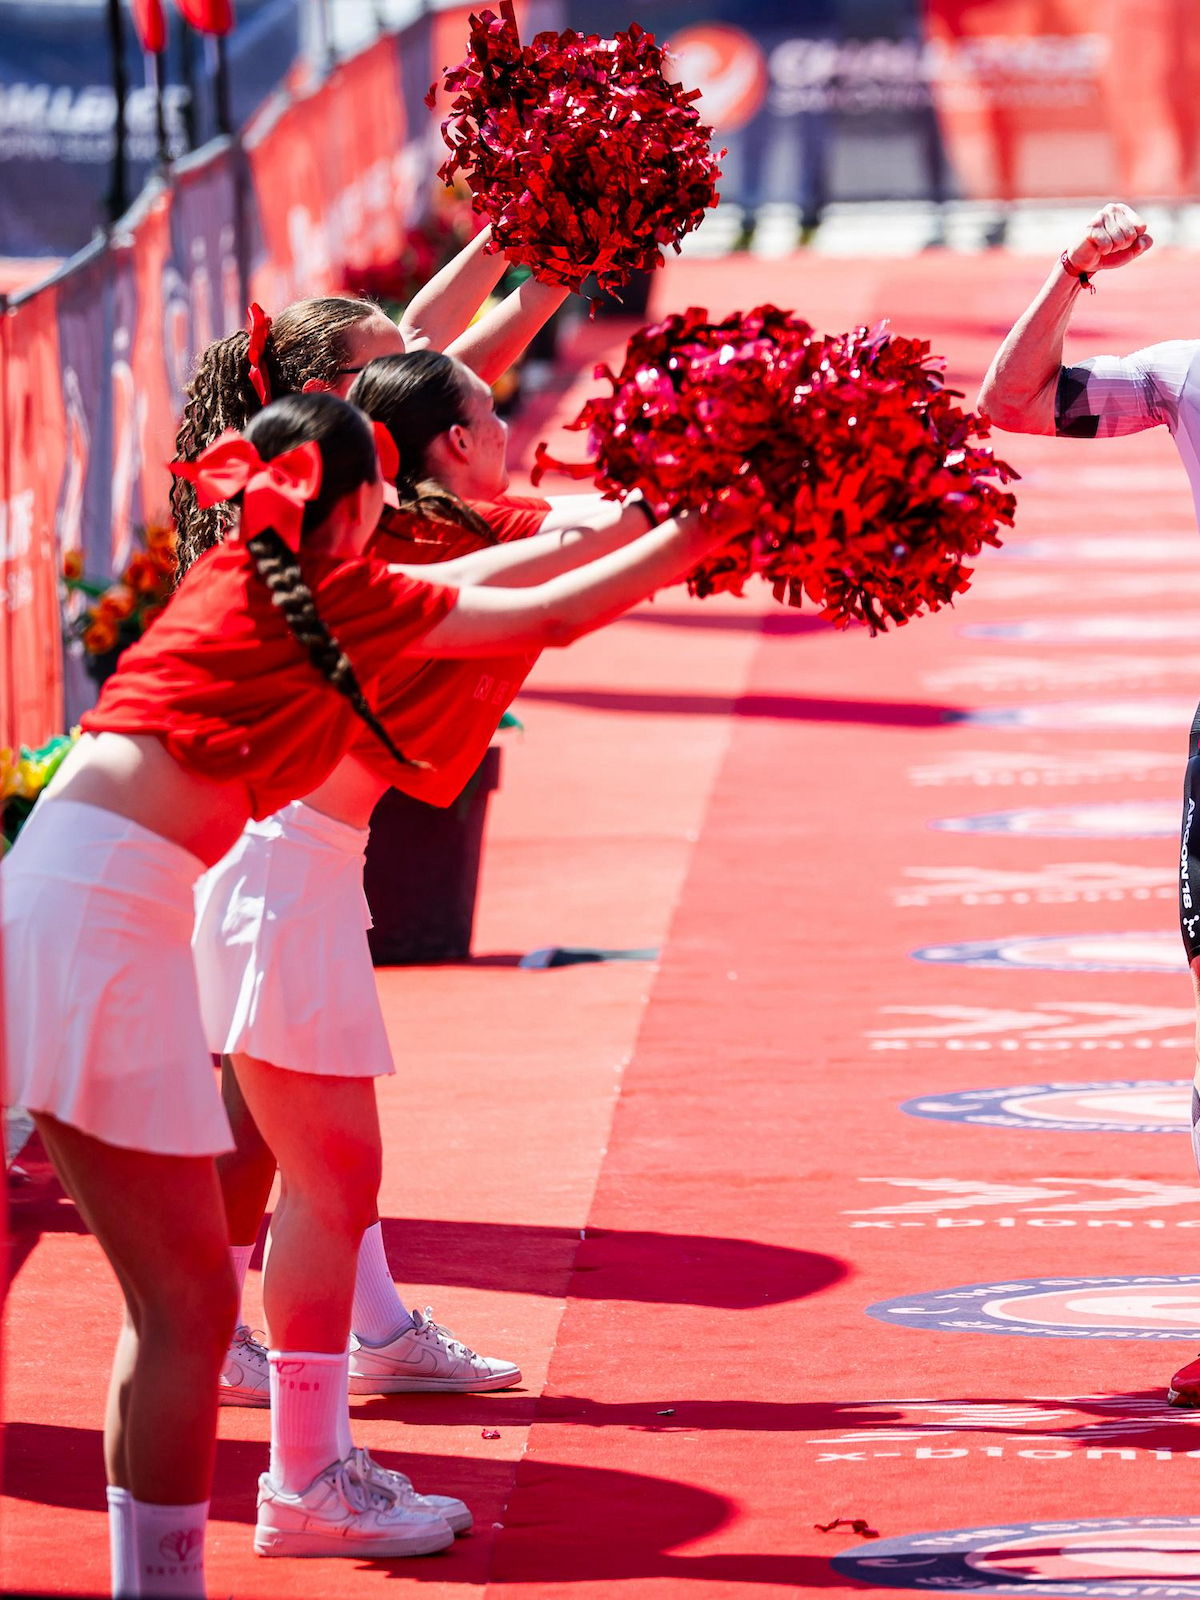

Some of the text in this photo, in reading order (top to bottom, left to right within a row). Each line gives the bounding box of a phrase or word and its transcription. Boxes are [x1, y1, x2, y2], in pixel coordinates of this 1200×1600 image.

[1180, 798, 1195, 909] ARGON 18
[935, 1284, 1036, 1299] THE
[910, 1528, 1026, 1547] THE
